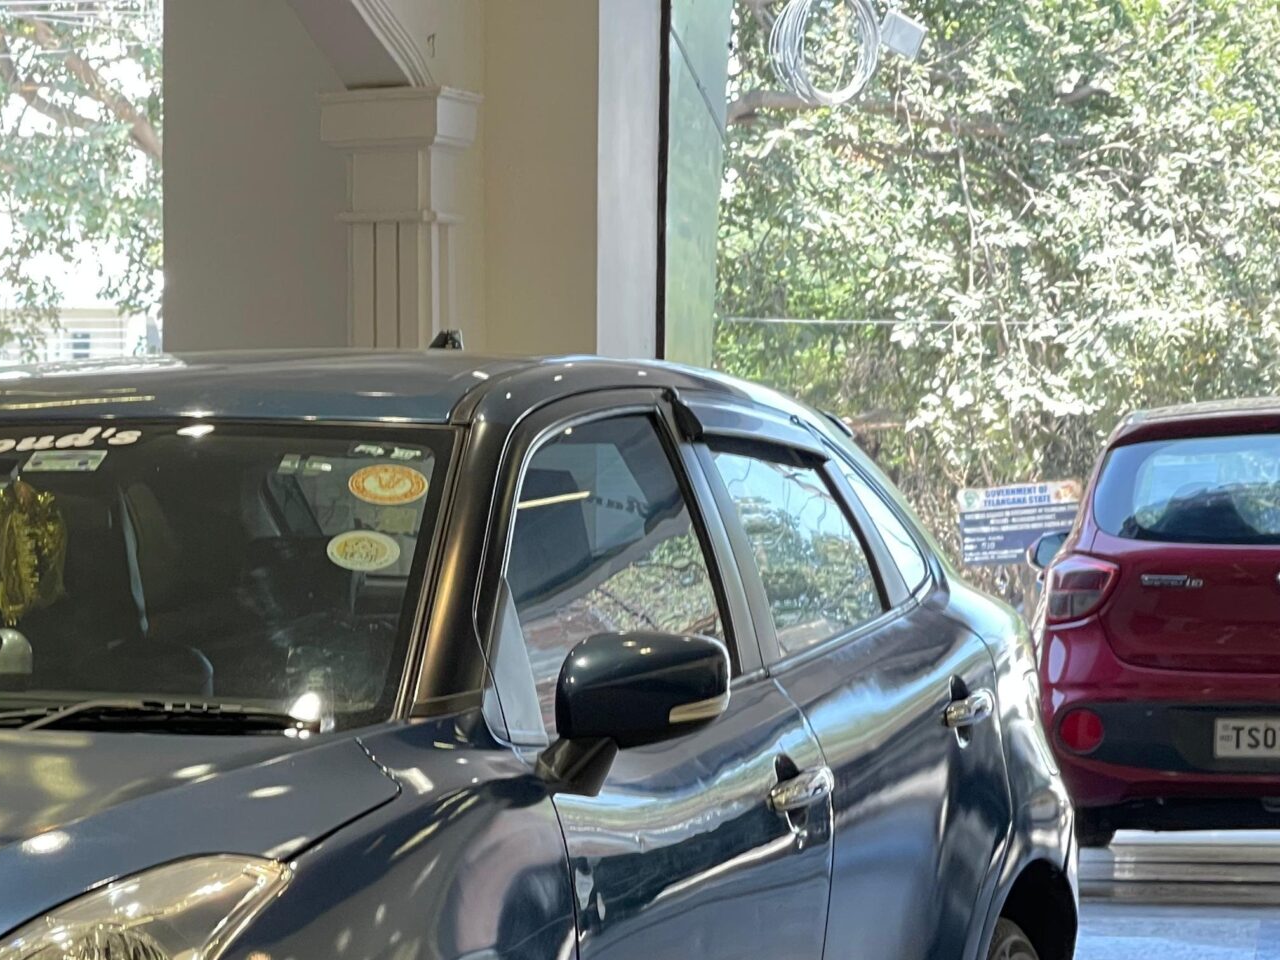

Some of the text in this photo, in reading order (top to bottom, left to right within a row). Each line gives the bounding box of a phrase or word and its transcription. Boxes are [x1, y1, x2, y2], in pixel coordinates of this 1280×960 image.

[985, 485, 1048, 498] GOVERNMENT OF
[983, 494, 1051, 507] TELANGANA STATE
[1232, 726, 1280, 749] TS0
